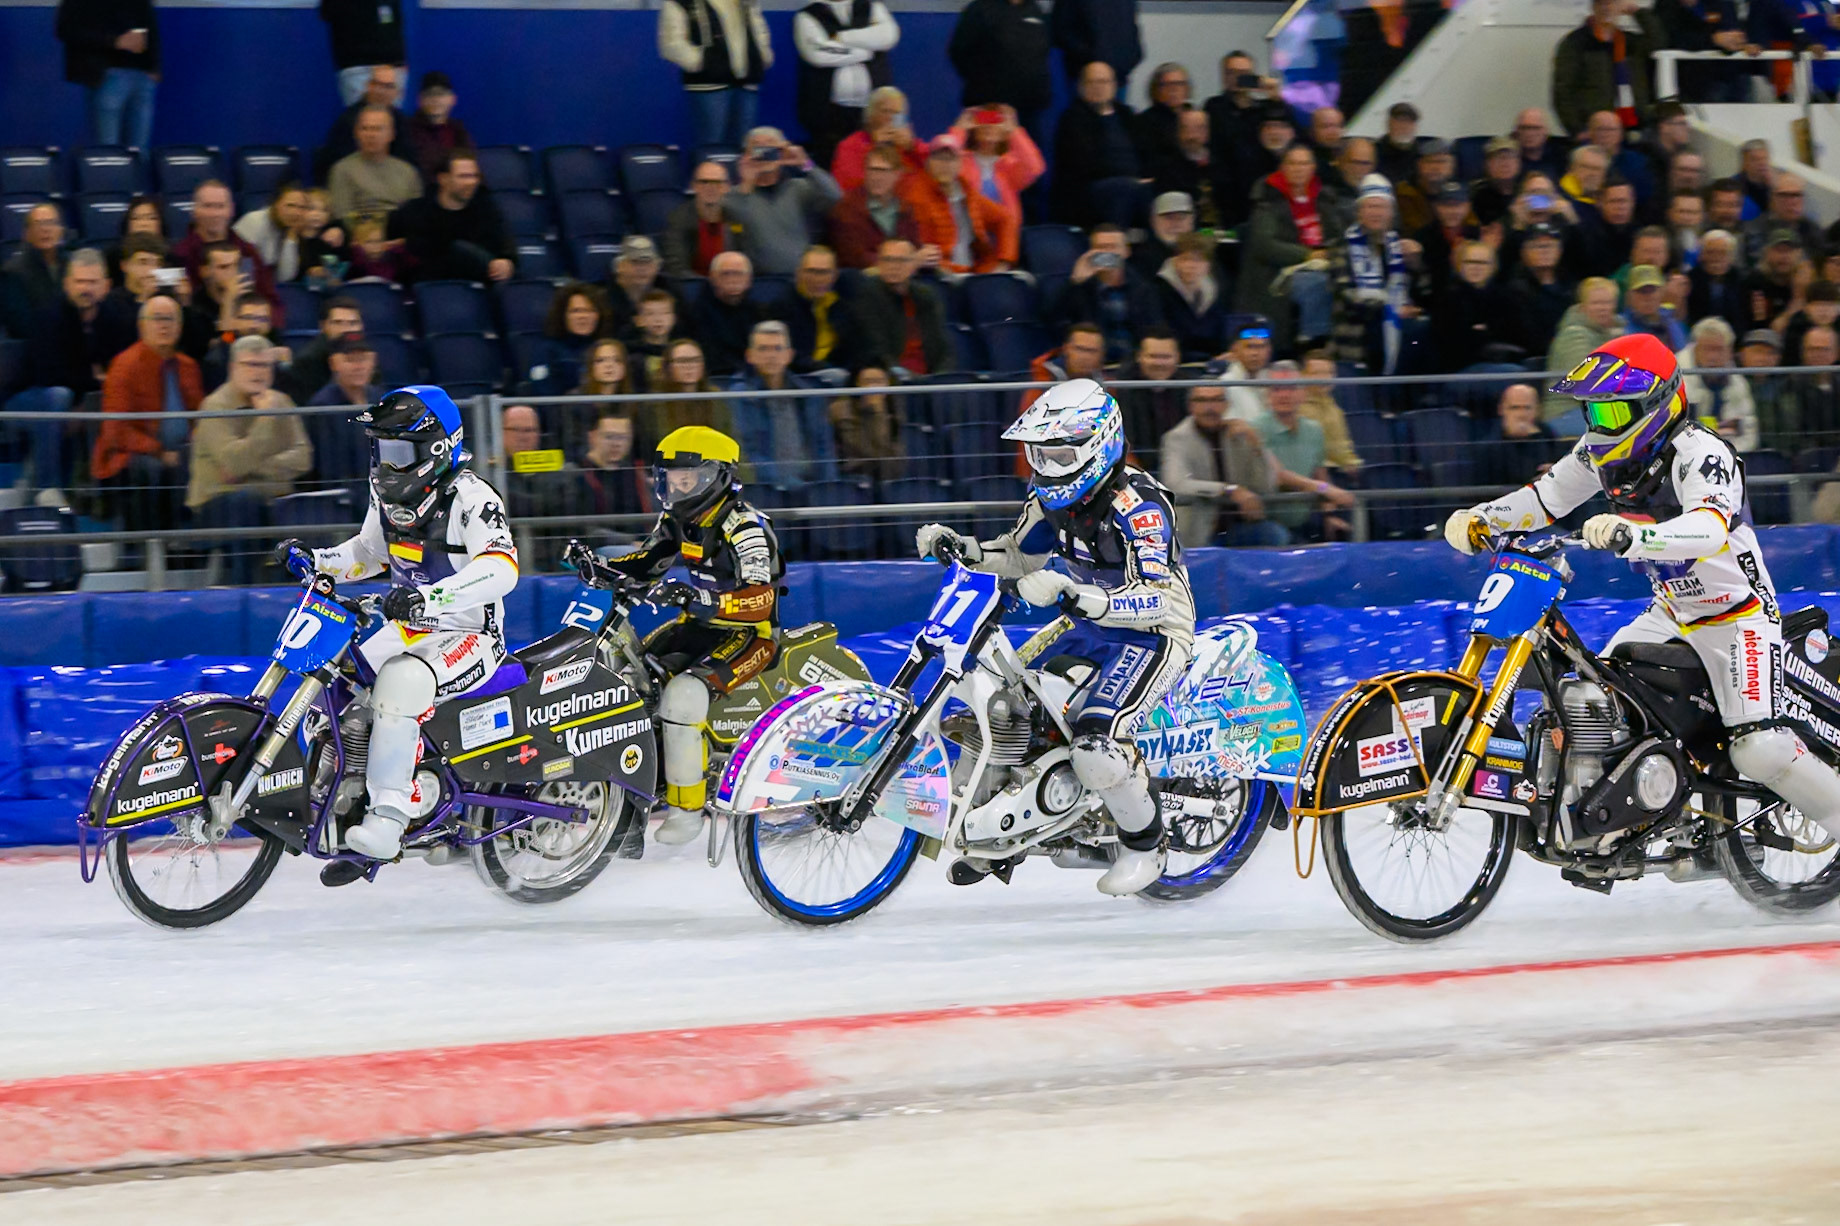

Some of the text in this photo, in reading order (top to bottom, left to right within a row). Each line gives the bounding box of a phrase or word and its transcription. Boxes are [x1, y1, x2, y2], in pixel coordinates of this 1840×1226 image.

[1473, 572, 1514, 614] 9
[1669, 577, 1703, 592] TEAM
[561, 601, 604, 631] 12
[928, 583, 979, 628] 11
[545, 664, 587, 684] KiMoto
[526, 685, 629, 728] kugelmann
[565, 717, 652, 757] Kunemann
[142, 763, 181, 777] KiMoto
[1340, 772, 1410, 798] kugelmann
[117, 783, 199, 814] kugelmann
